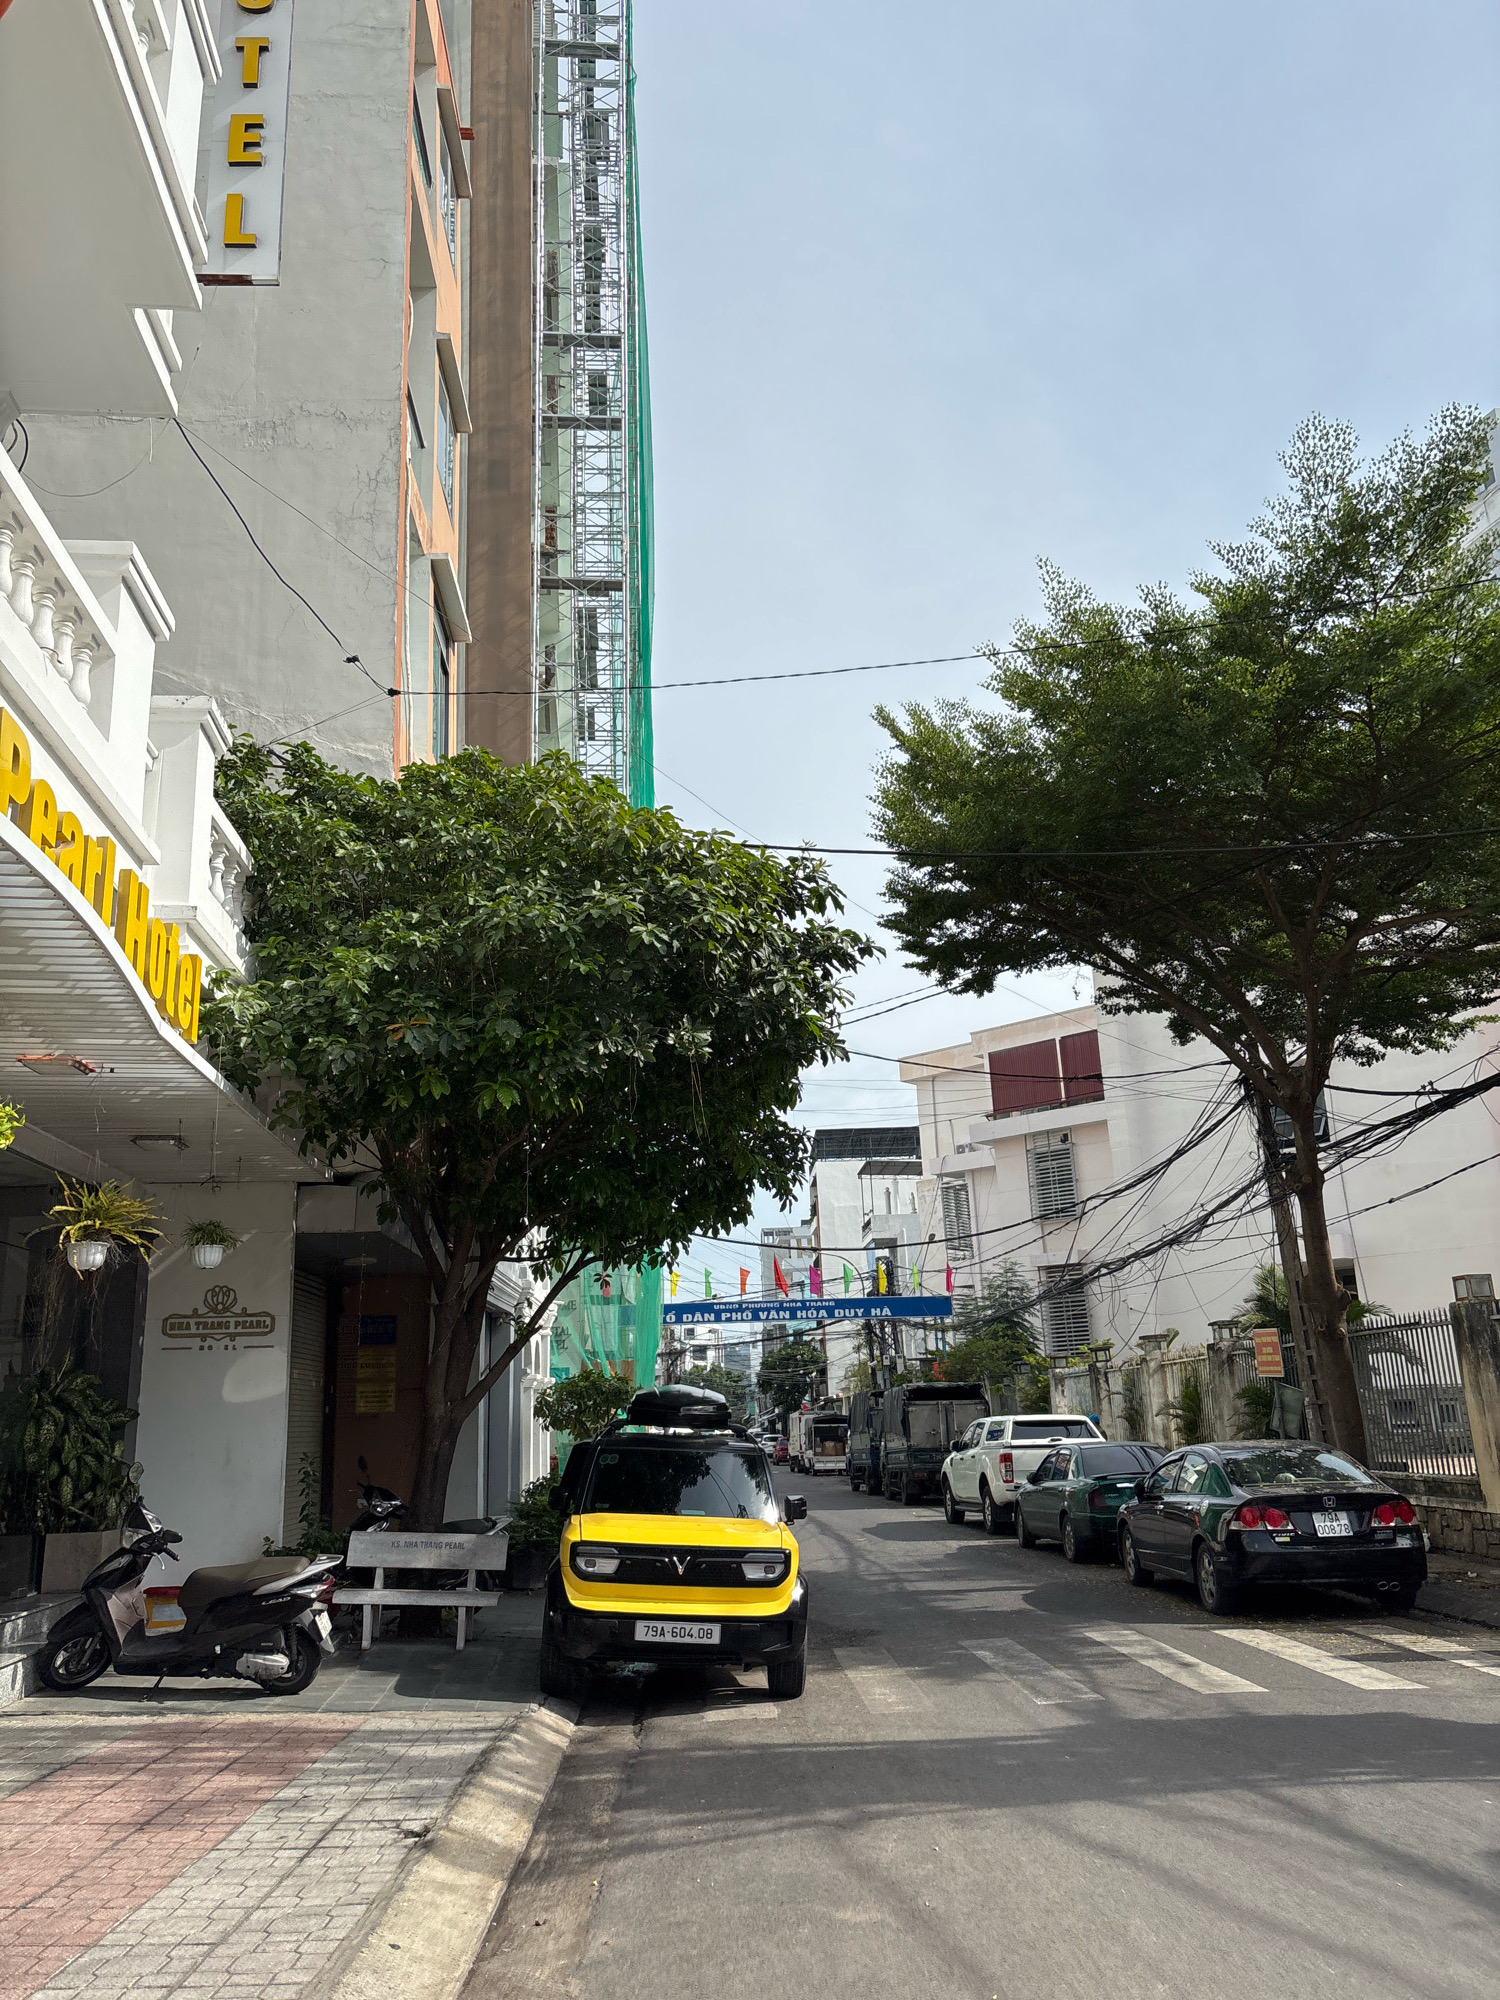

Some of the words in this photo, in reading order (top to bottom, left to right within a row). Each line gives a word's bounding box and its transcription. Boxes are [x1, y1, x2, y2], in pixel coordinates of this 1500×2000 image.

[224, 0, 276, 249] TEL
[0, 706, 116, 929] Pearl
[115, 869, 202, 1045] Hotel
[663, 1310, 676, 1323] Ổ
[682, 1311, 715, 1322] DÂN
[721, 1309, 753, 1321] PHỐ
[758, 1310, 790, 1320] VĂN
[796, 1307, 828, 1319] HÓA
[834, 1308, 864, 1317] DUY
[870, 1306, 892, 1316] HÀ
[168, 1320, 192, 1332] NHA
[194, 1320, 231, 1331] TRANG
[234, 1319, 269, 1330] PEARL
[1321, 1512, 1340, 1523] 79A
[403, 1541, 418, 1549] NHA
[420, 1541, 443, 1549] TRANG
[444, 1542, 466, 1550] PEARL
[643, 1625, 713, 1639] 79A-604.08
